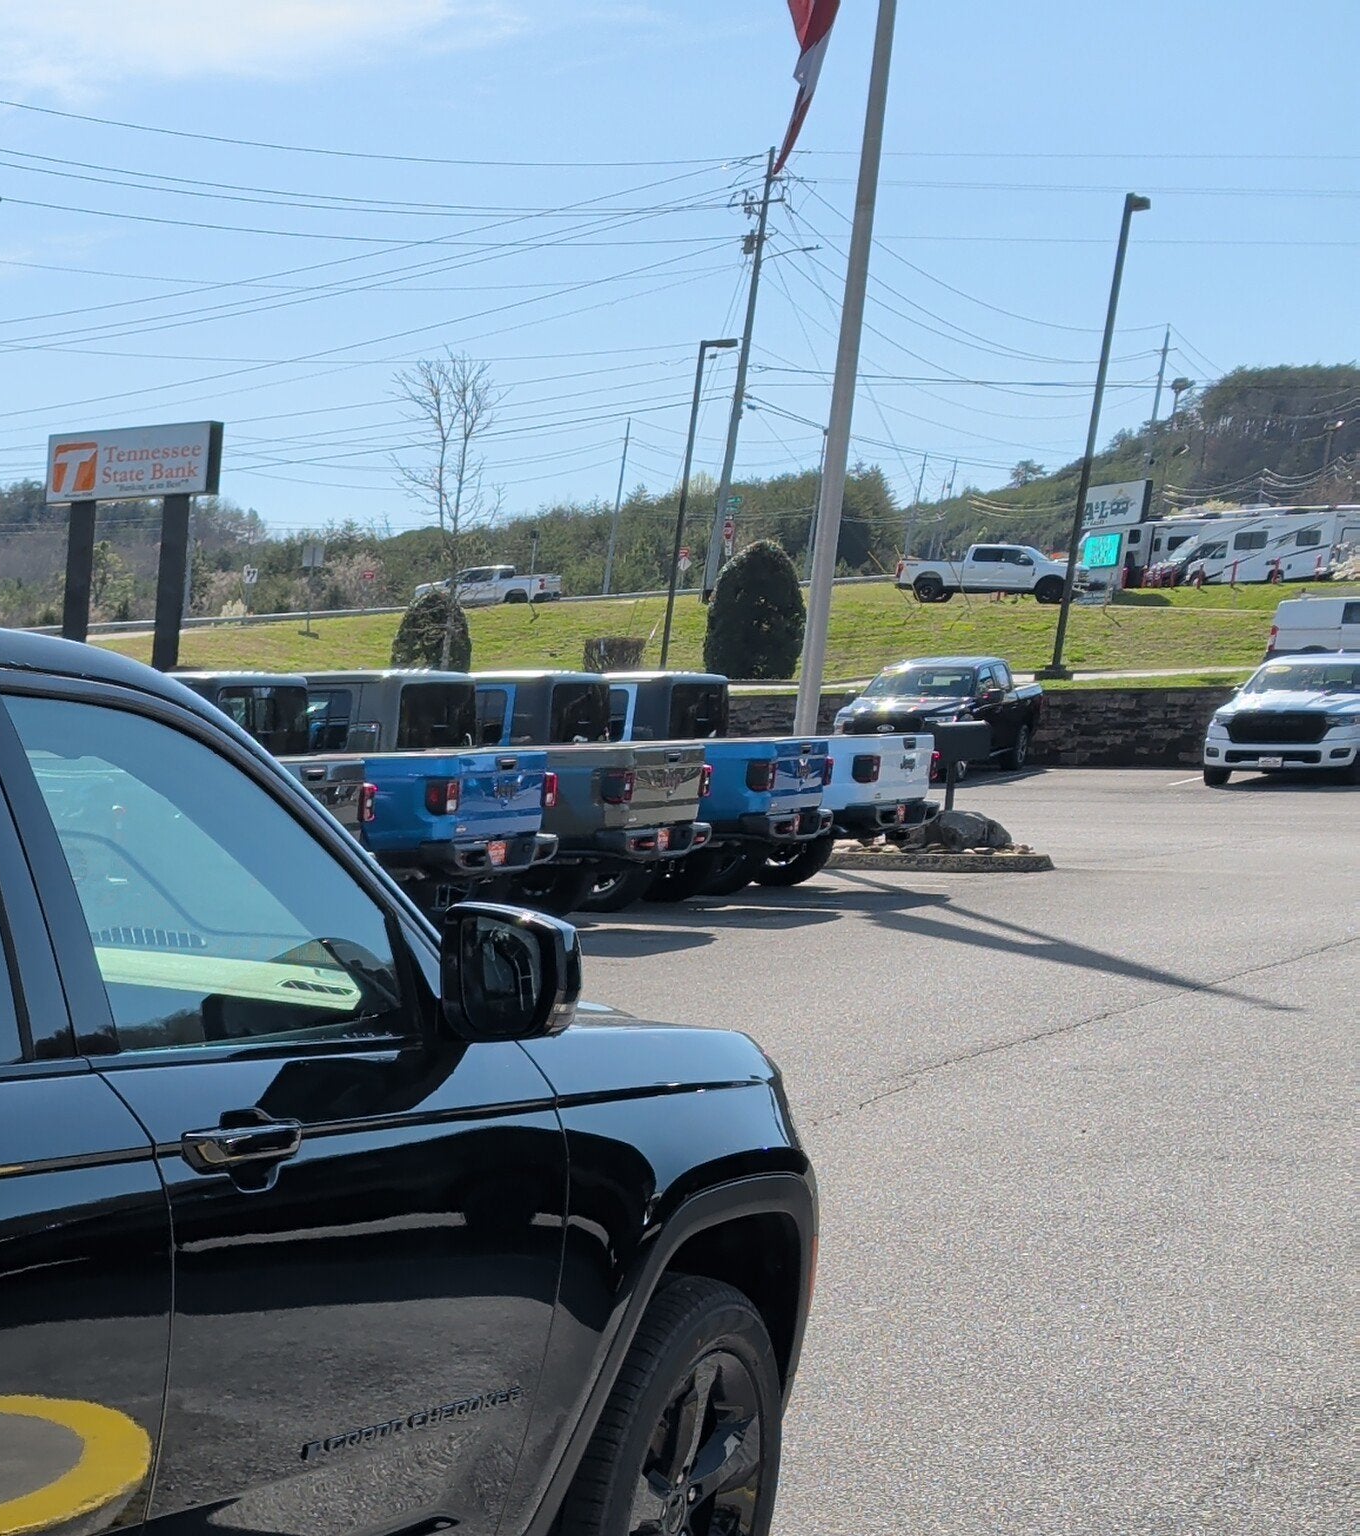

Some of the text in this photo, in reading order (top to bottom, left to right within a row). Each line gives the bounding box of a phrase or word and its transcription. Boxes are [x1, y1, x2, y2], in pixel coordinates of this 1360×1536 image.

[104, 443, 202, 463] Tennessee
[102, 461, 199, 484] State Bank
